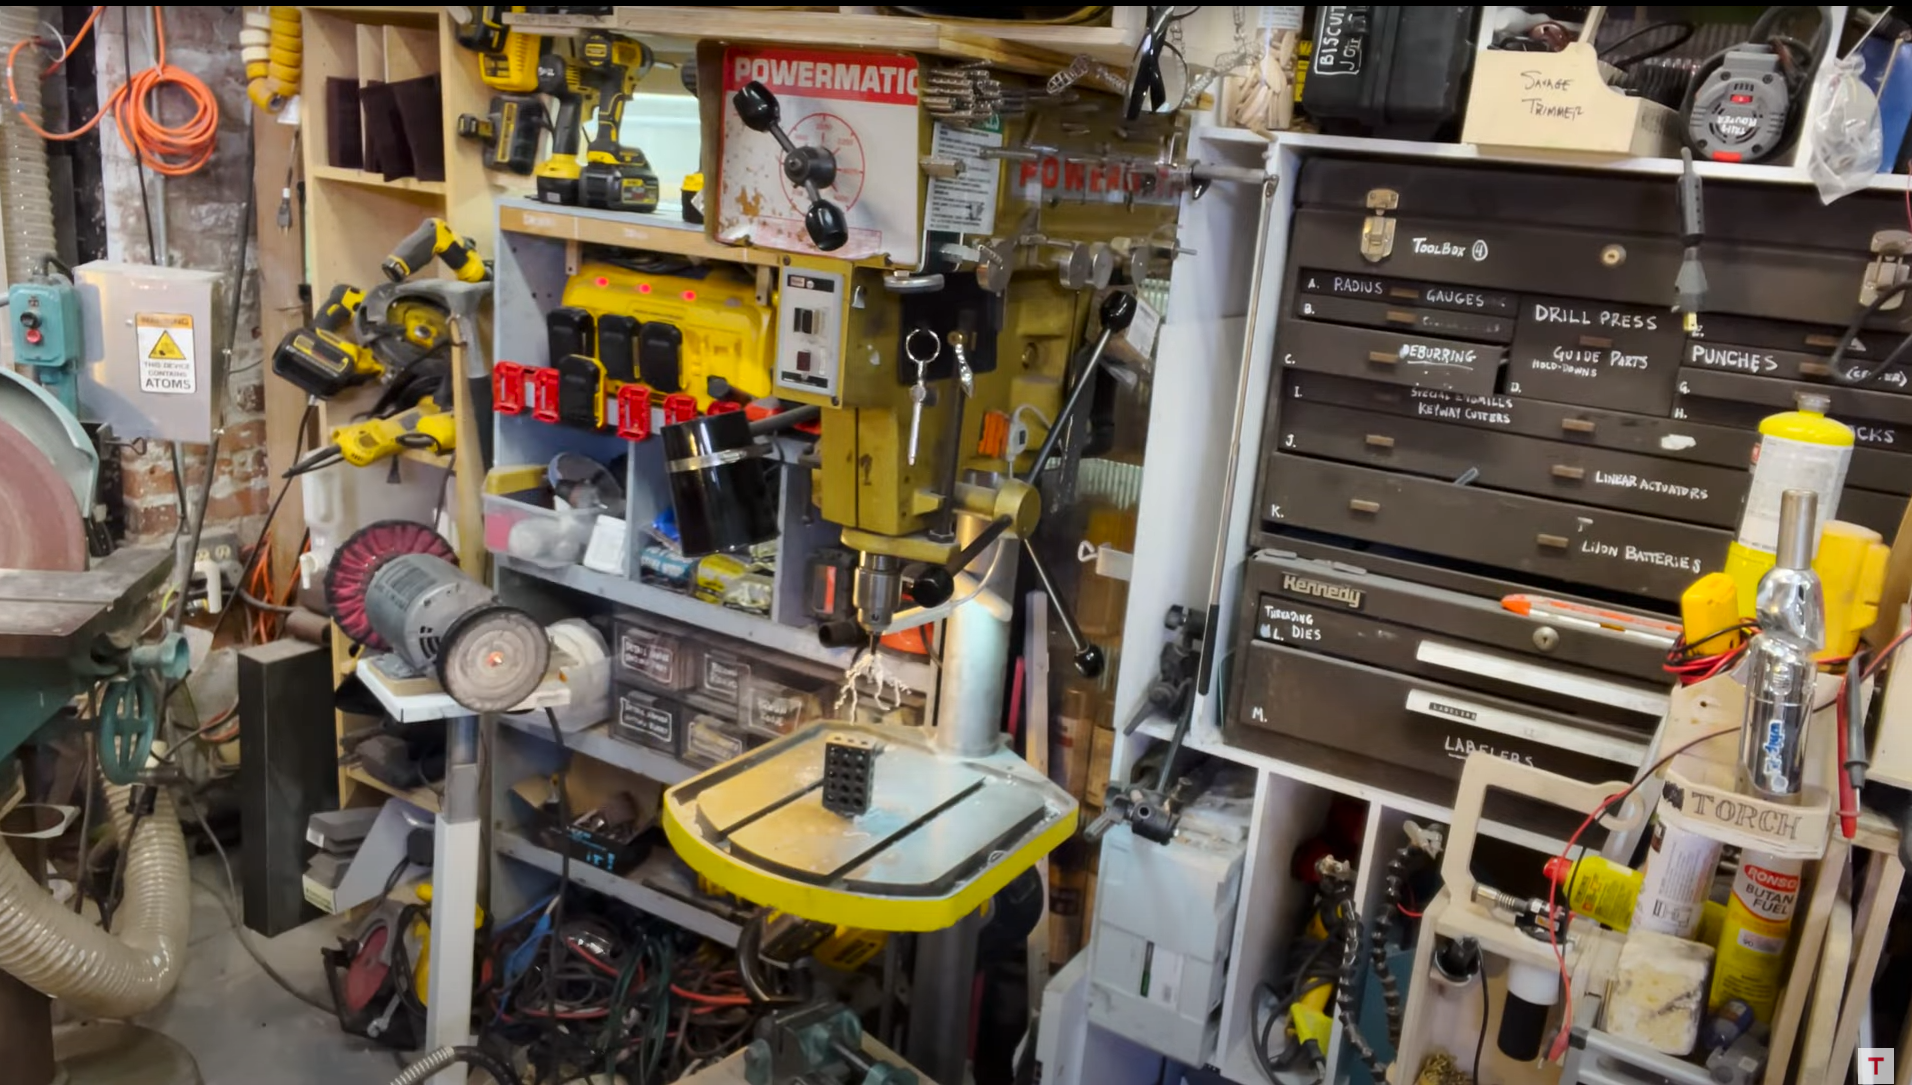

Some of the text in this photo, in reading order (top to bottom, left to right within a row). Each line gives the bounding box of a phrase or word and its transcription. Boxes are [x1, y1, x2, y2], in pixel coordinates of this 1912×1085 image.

[1319, 6, 1347, 66] BISCUIT
[734, 56, 919, 96] POWERMATIC
[1520, 70, 1574, 91] SAVAGE
[1521, 98, 1585, 121] TRIMMER
[1334, 277, 1383, 294] RADIUS
[1426, 289, 1485, 307] GAUGES
[1535, 304, 1658, 330] DRILL PRESS
[144, 361, 190, 370] THIS DEVICE
[1400, 344, 1477, 364] DEBURRING
[1553, 346, 1649, 369] GUIDE PARTS
[1691, 345, 1779, 373] PUNCHES
[1532, 358, 1598, 378] HOLD-DOWNS
[145, 377, 192, 390] ATOMS
[1418, 401, 1511, 424] KEYWAY CUTTERS
[1595, 470, 1709, 500] LINEAR ACTUATORS
[1625, 545, 1702, 573] BATTERIES
[1283, 574, 1361, 608] Kennedy
[1264, 604, 1315, 625] THREADING
[1292, 624, 1322, 641] DIES
[1691, 791, 1803, 840] TORCH
[1753, 898, 1789, 915] FUEL
